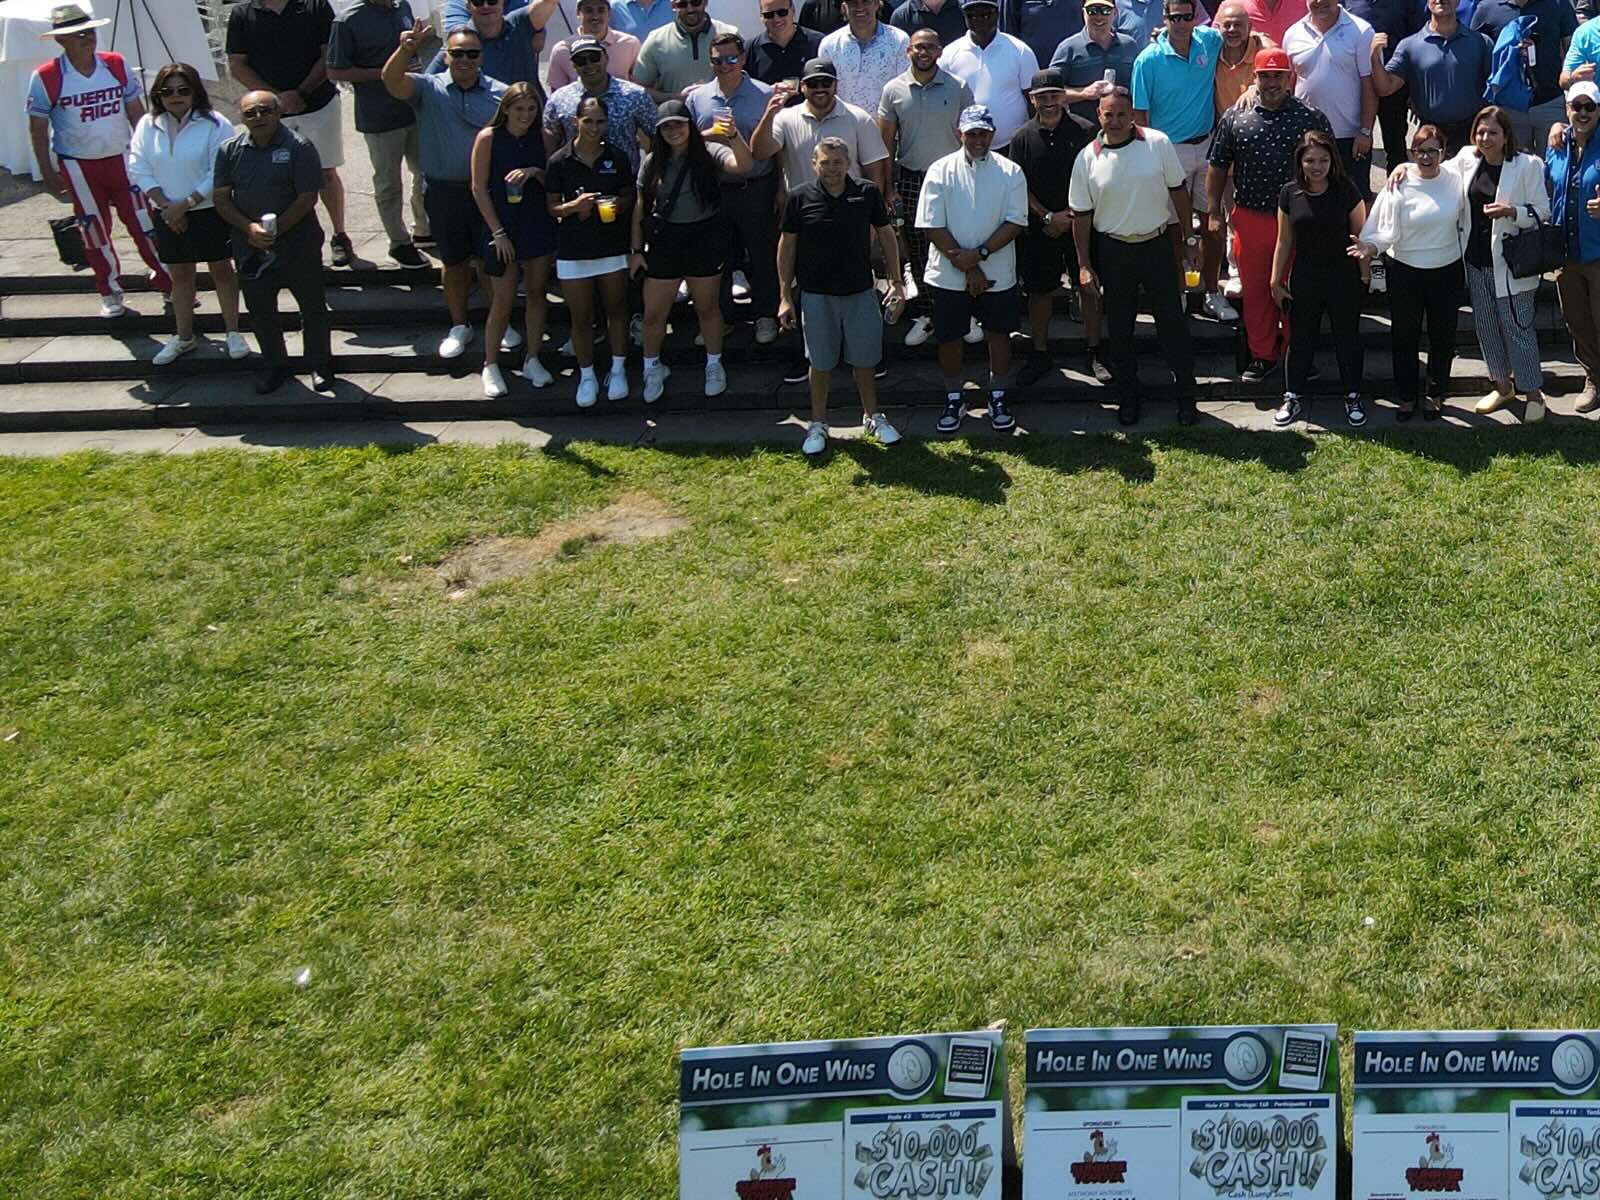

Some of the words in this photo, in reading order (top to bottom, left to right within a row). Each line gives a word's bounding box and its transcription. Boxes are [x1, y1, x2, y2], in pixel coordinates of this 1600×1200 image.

[60, 85, 124, 111] PUERTO
[80, 100, 121, 123] RICO
[692, 1067, 744, 1092] HOLE
[825, 1059, 876, 1081] WINS
[1036, 1050, 1086, 1073] HOLE
[1163, 1047, 1213, 1069] WINS
[1364, 1051, 1415, 1073] HOLE
[1491, 1050, 1541, 1073] WINS
[871, 1129, 977, 1162] $10,000
[1200, 1119, 1319, 1152] $100,000
[870, 1159, 977, 1199] CASH!
[1205, 1151, 1311, 1188] CASH!
